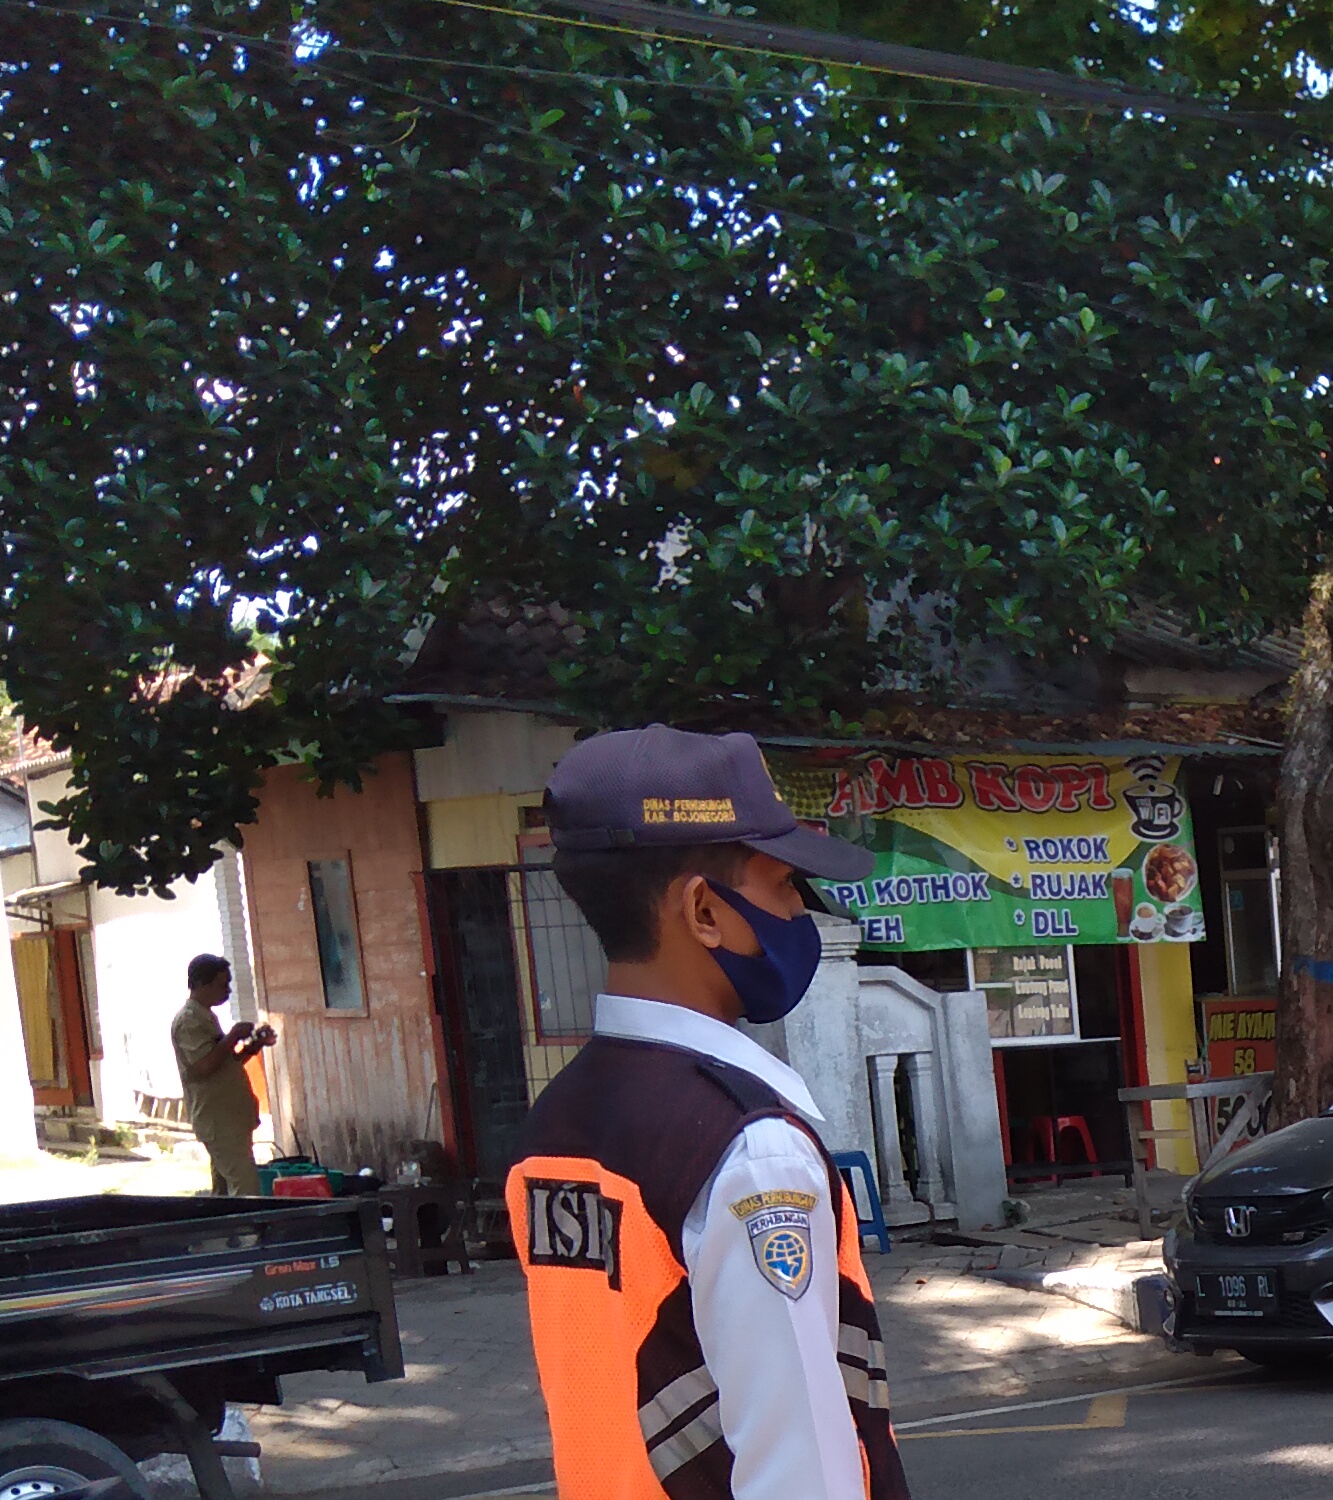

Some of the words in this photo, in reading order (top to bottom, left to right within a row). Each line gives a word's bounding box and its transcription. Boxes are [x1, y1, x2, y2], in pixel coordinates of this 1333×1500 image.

[966, 760, 1116, 812] KOPI
[643, 798, 671, 811] DINAS
[673, 810, 736, 823] BOJONEGORO
[1023, 836, 1110, 863] ROKOK
[874, 872, 991, 905] KOTHOK
[1030, 873, 1108, 899] RUJAK
[1033, 910, 1078, 936] DLL
[1210, 1013, 1234, 1040] MIE
[1237, 1011, 1276, 1040] AYAM
[1234, 1048, 1256, 1074] 58
[737, 1195, 761, 1215] DINAS
[265, 1263, 292, 1276] Gran
[1196, 1275, 1206, 1296] L
[1218, 1275, 1247, 1297] 1096
[1257, 1275, 1273, 1297] RL
[276, 1293, 303, 1308] KOTA
